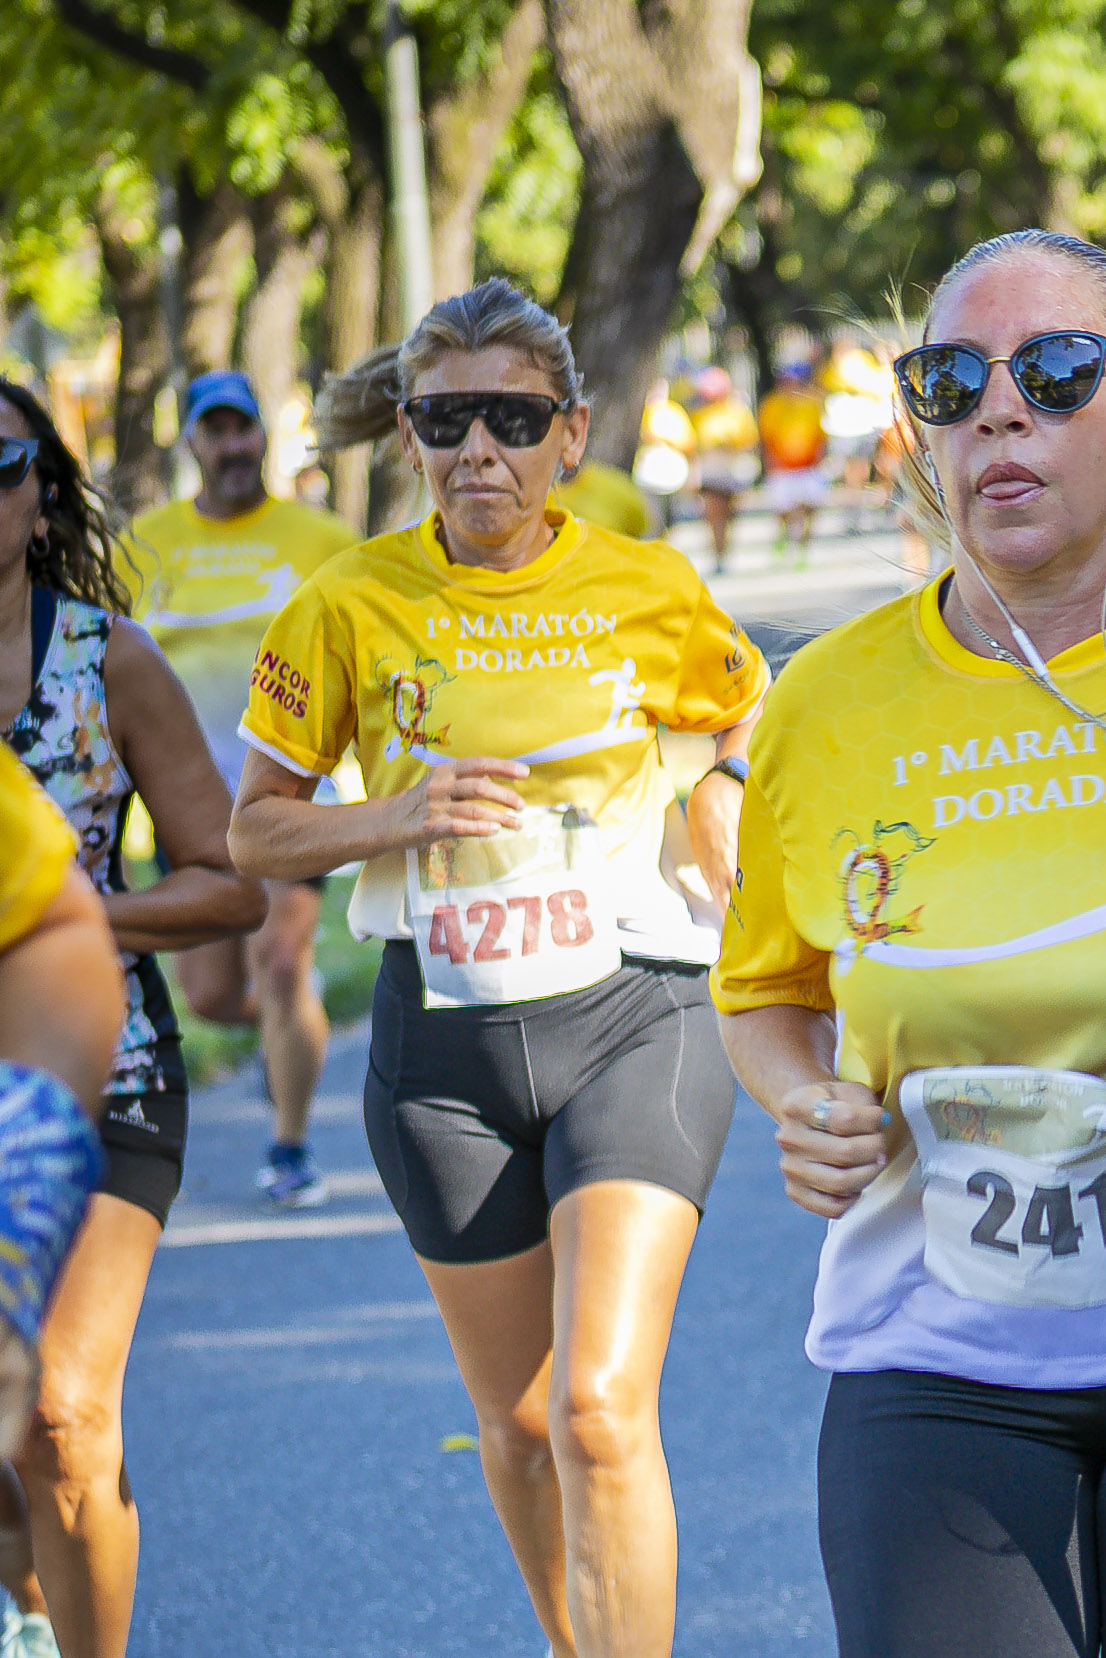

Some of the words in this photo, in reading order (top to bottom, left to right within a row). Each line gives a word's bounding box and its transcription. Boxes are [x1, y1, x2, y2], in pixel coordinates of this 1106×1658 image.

[459, 608, 617, 639] MARATÓN
[254, 647, 311, 700] NCOR
[455, 643, 591, 672] DORADA
[429, 889, 595, 965] 4278
